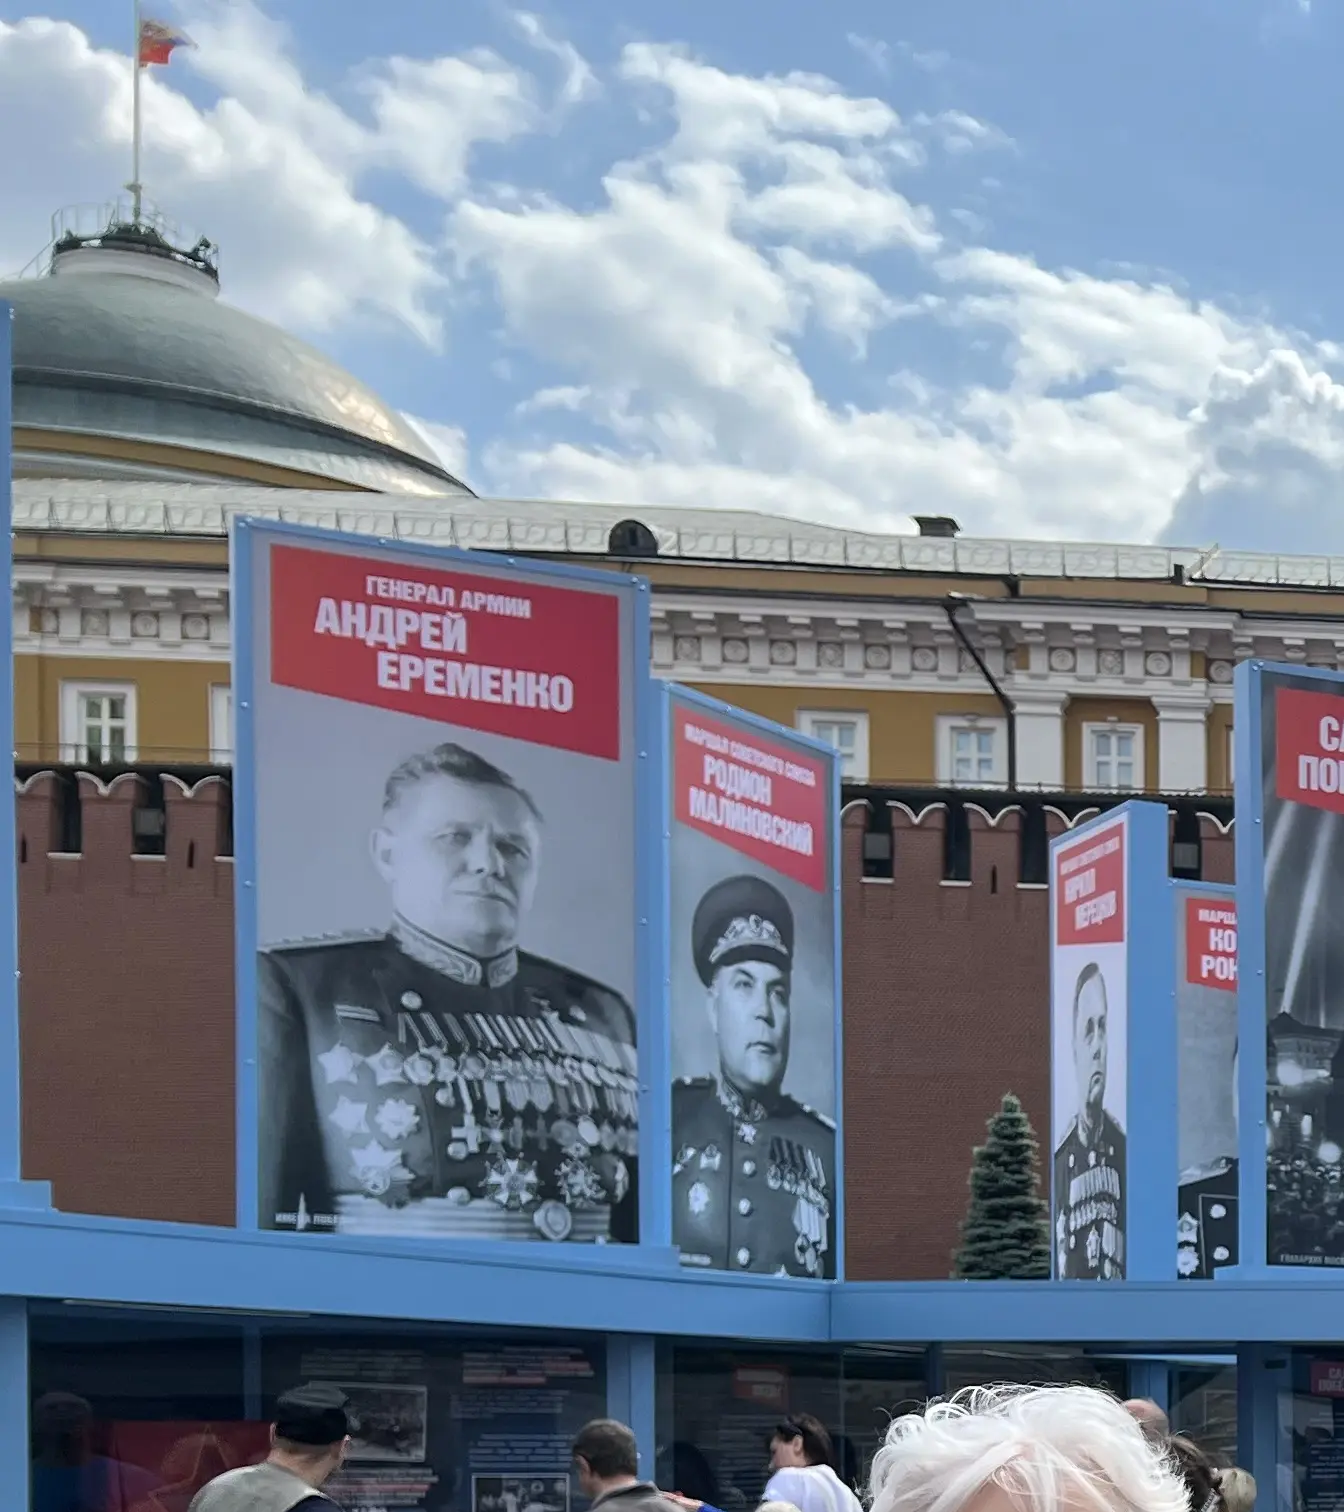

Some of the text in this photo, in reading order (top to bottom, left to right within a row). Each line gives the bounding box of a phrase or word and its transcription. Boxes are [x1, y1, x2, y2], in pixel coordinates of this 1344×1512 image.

[366, 575, 532, 619] ГЕНЕРАЛ АРМИИ
[314, 598, 467, 654] АНДРЕЙ
[377, 651, 574, 713] ЕРЕМЕНКО
[703, 753, 772, 807] РОДИОН
[689, 785, 813, 856] МАЛИНОВСКИЙ
